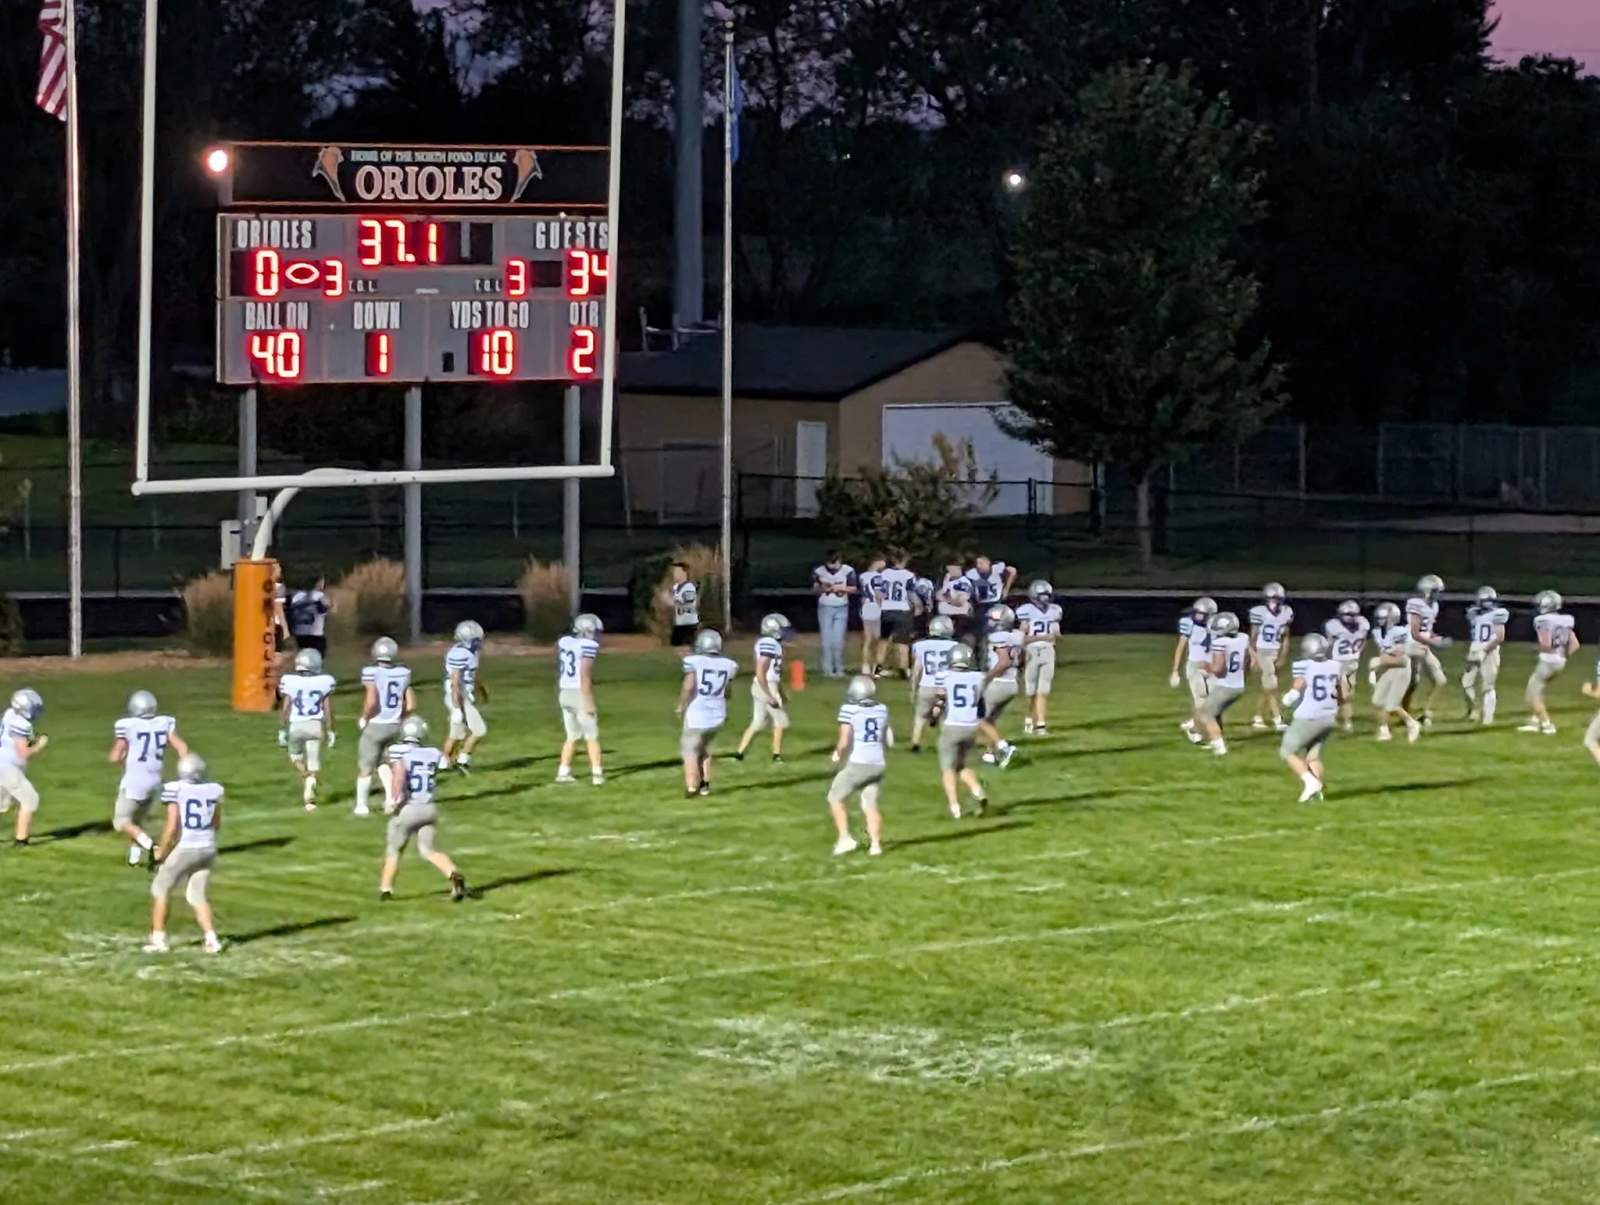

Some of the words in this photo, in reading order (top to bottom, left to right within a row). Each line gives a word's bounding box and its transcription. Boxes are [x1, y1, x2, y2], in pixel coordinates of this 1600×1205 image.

[489, 152, 507, 163] LAC
[355, 164, 502, 201] ORIOLES
[237, 219, 313, 249] ORIOLES
[360, 219, 438, 266] 37.1
[535, 221, 609, 250] GUESTS
[255, 250, 280, 297] 0
[325, 259, 343, 297] 3
[508, 259, 526, 296] 3
[569, 250, 609, 296] 34
[245, 301, 282, 331] BALL
[286, 301, 309, 330] ON
[353, 301, 401, 331] DOWN
[451, 301, 482, 329] YDS
[485, 301, 505, 329] TO
[507, 301, 530, 329] GO
[251, 331, 301, 378] 40
[379, 334, 388, 374] 1
[482, 330, 514, 375] 10
[572, 329, 595, 374] 2
[385, 680, 400, 709] 6
[698, 668, 728, 696] 57
[953, 683, 977, 708] 51
[864, 716, 879, 743] 8
[137, 731, 168, 762] 75
